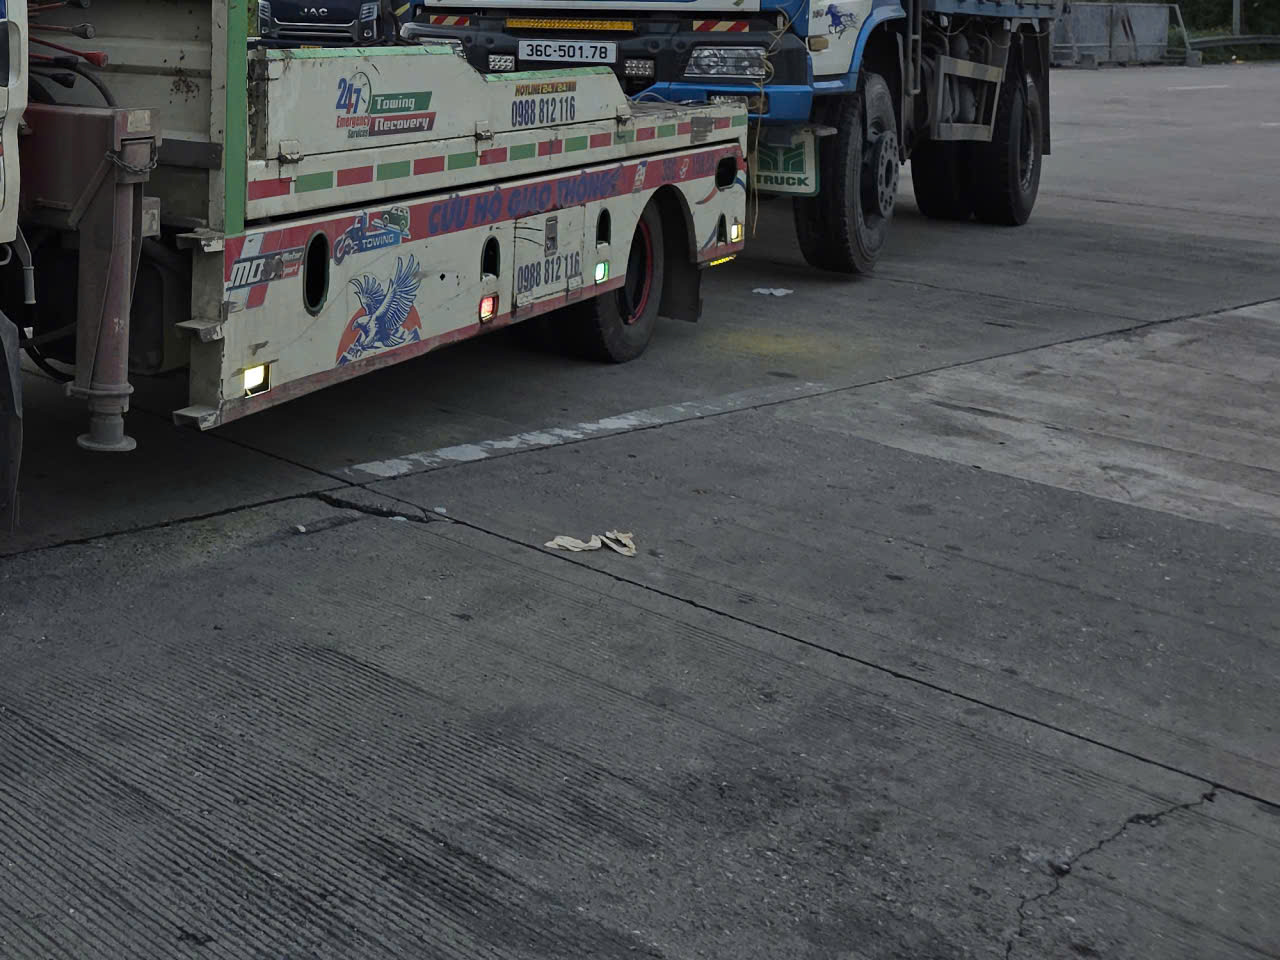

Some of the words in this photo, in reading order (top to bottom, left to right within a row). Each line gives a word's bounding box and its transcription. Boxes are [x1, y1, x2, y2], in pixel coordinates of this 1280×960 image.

[300, 7, 328, 17] JAC
[526, 44, 608, 59] 36C-501.78
[375, 95, 415, 110] Towing
[512, 99, 536, 127] 0988
[539, 97, 556, 124] 812
[559, 96, 576, 122] 116
[374, 117, 430, 131] Recovery
[756, 175, 810, 187] TRUCK
[362, 233, 395, 248] TOWING
[517, 261, 541, 294] 0988
[544, 255, 561, 285] 812
[564, 251, 580, 279] 116
